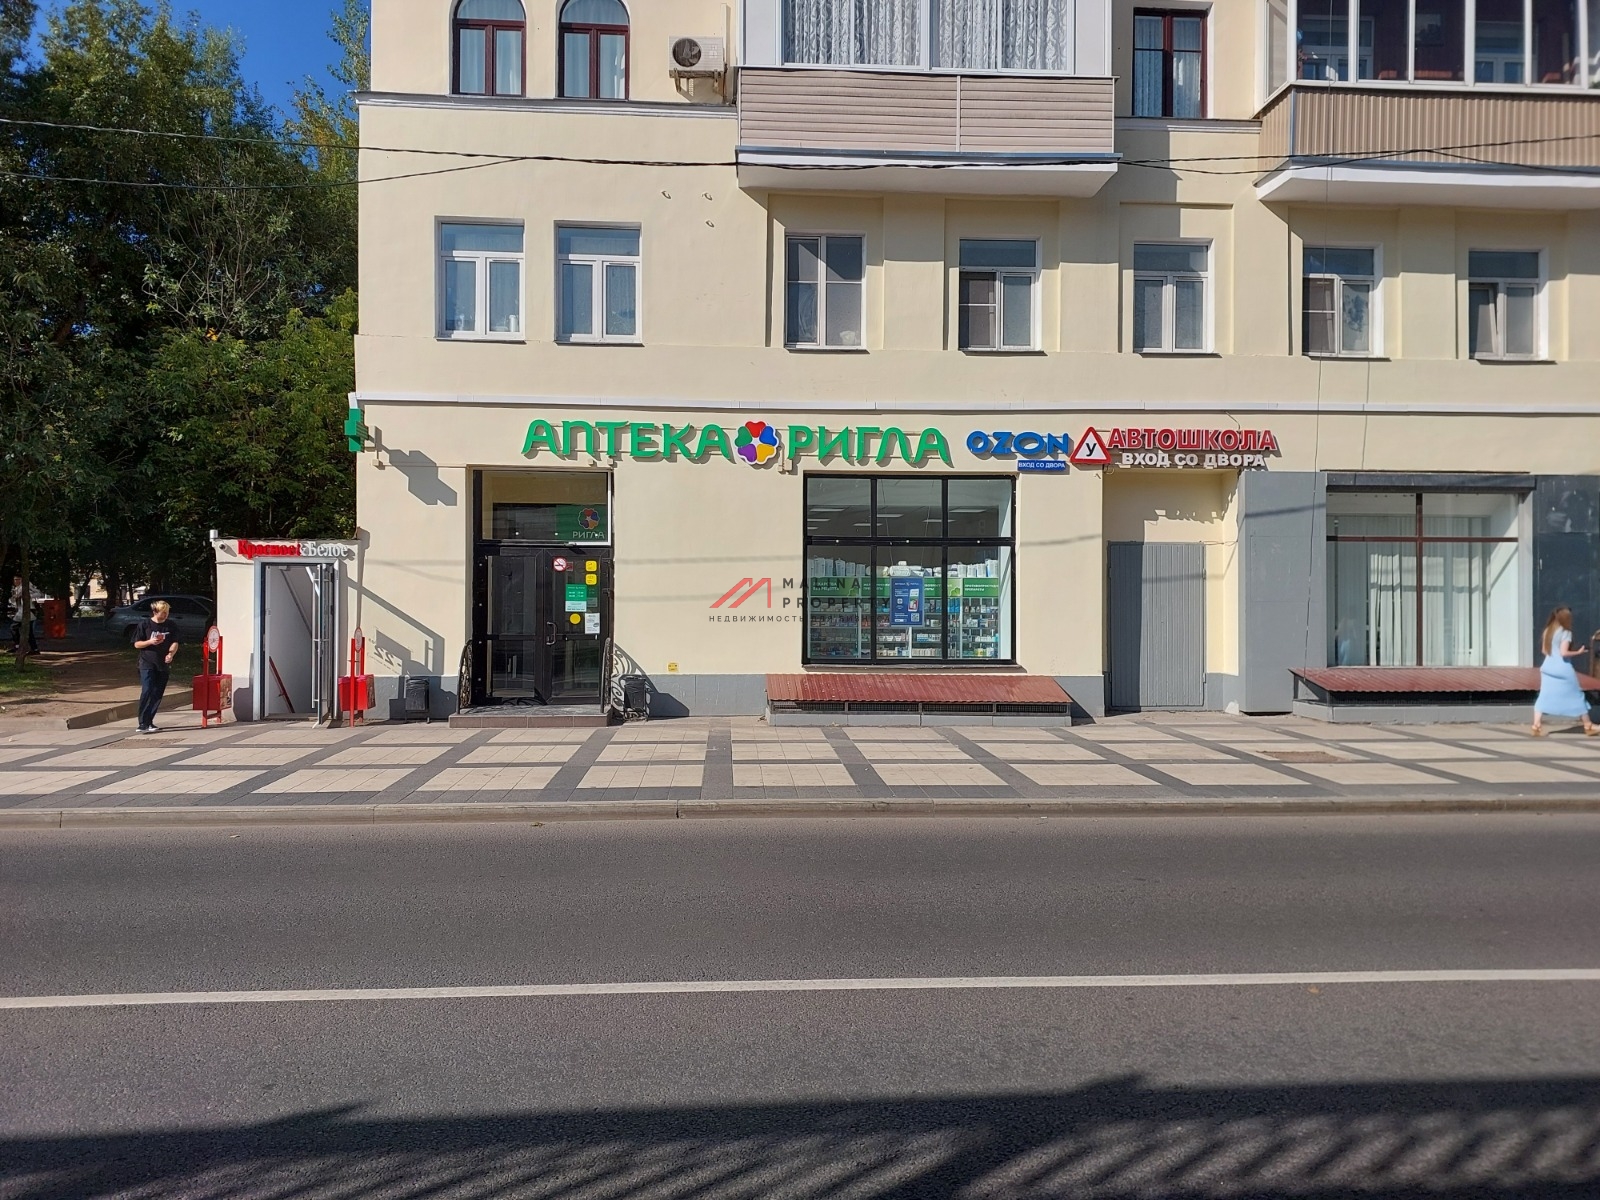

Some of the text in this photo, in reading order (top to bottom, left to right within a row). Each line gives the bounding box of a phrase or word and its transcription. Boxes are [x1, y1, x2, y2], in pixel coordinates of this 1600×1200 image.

[522, 419, 949, 464] АПТЕКА РИГЛА
[966, 430, 1070, 455] OZON
[1107, 428, 1278, 451] АВТОШКОЛА
[1122, 452, 1266, 468] ВХОД СО ДВОРА
[572, 531, 605, 540] РИГЛА
